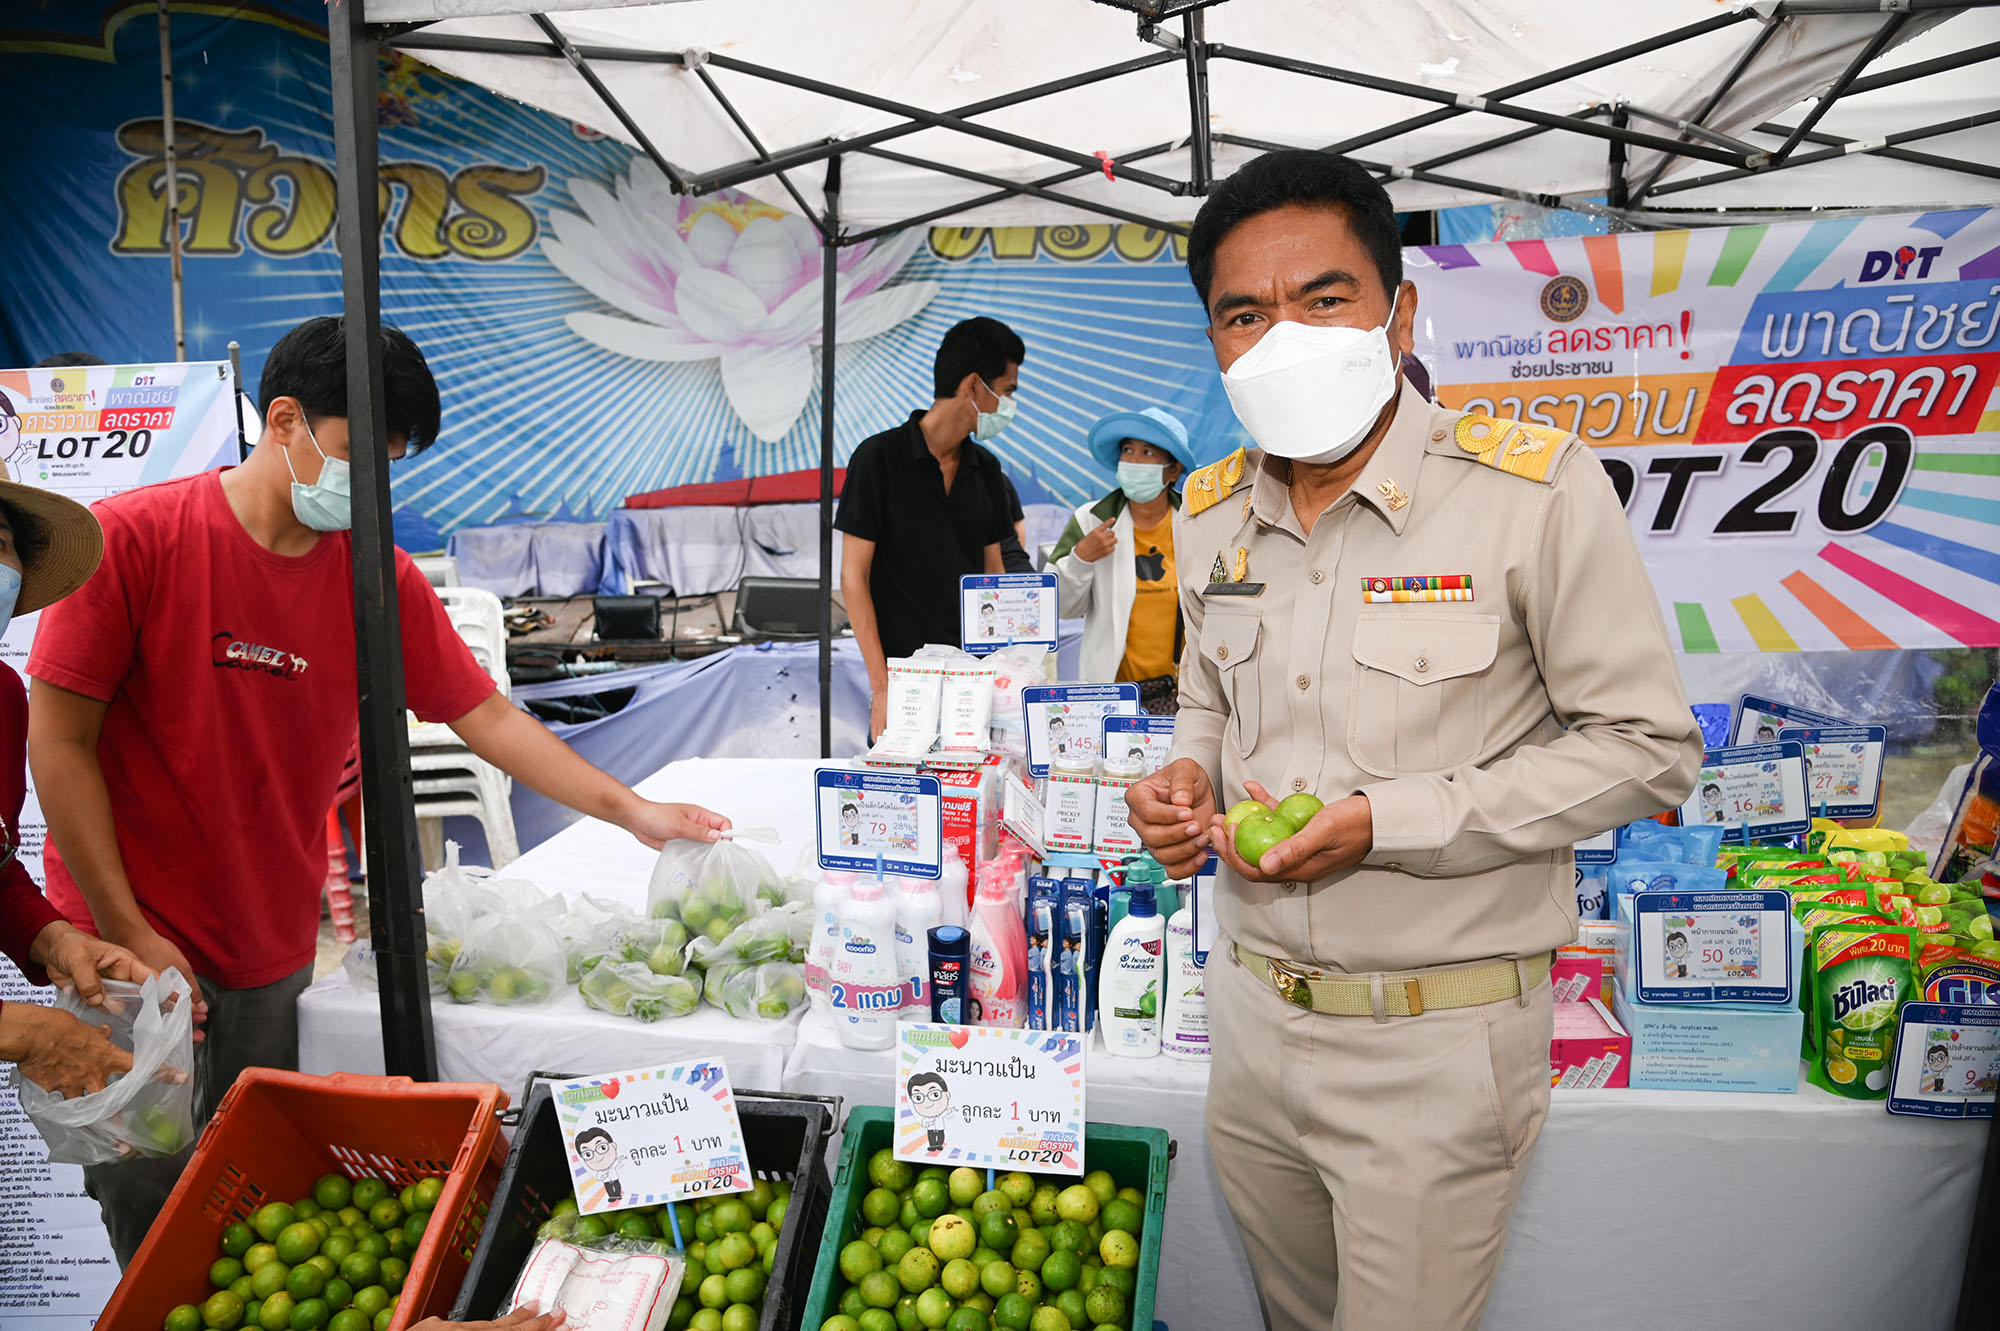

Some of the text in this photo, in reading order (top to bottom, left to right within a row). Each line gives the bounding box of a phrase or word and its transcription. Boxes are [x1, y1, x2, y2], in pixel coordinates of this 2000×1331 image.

[1456, 309, 1693, 361] พาณิชย์ ลดราคา!
[1511, 359, 1613, 378] ช่วยประชาชน
[111, 386, 176, 406] พาณิชย์
[1726, 363, 1977, 426] ลดราคา
[26, 412, 97, 431] คาราวาน
[105, 410, 173, 428] ลดราคา
[37, 430, 152, 459] LOT 20
[1713, 427, 1915, 534] 20
[226, 641, 286, 666] CAMEL
[1067, 737, 1092, 749] 145
[1815, 775, 1833, 789] 27
[1734, 799, 1753, 813] 16
[869, 822, 887, 835] 79
[893, 822, 912, 831] 28%
[1577, 891, 1607, 916] fort
[1691, 927, 1738, 936] หน้ากากอนามัย
[1729, 946, 1753, 955] 60%
[1870, 938, 1886, 952] 20
[1887, 944, 1905, 954] บาท
[1702, 949, 1723, 963] 50
[837, 960, 852, 973] BABY
[831, 976, 921, 1009] 2 แถม 1
[1833, 977, 1895, 1021] ซันไลต์
[992, 1008, 1013, 1020] 1+1
[936, 1055, 1036, 1079] มะนาวแป้น
[1988, 1062, 2000, 1071] 55
[1965, 1070, 1976, 1085] 9
[594, 1092, 689, 1124] มะนาวแป้น
[962, 1101, 1061, 1123] ลูกละ 1 บาท
[629, 1134, 722, 1166] ลูกละ 1 บาท
